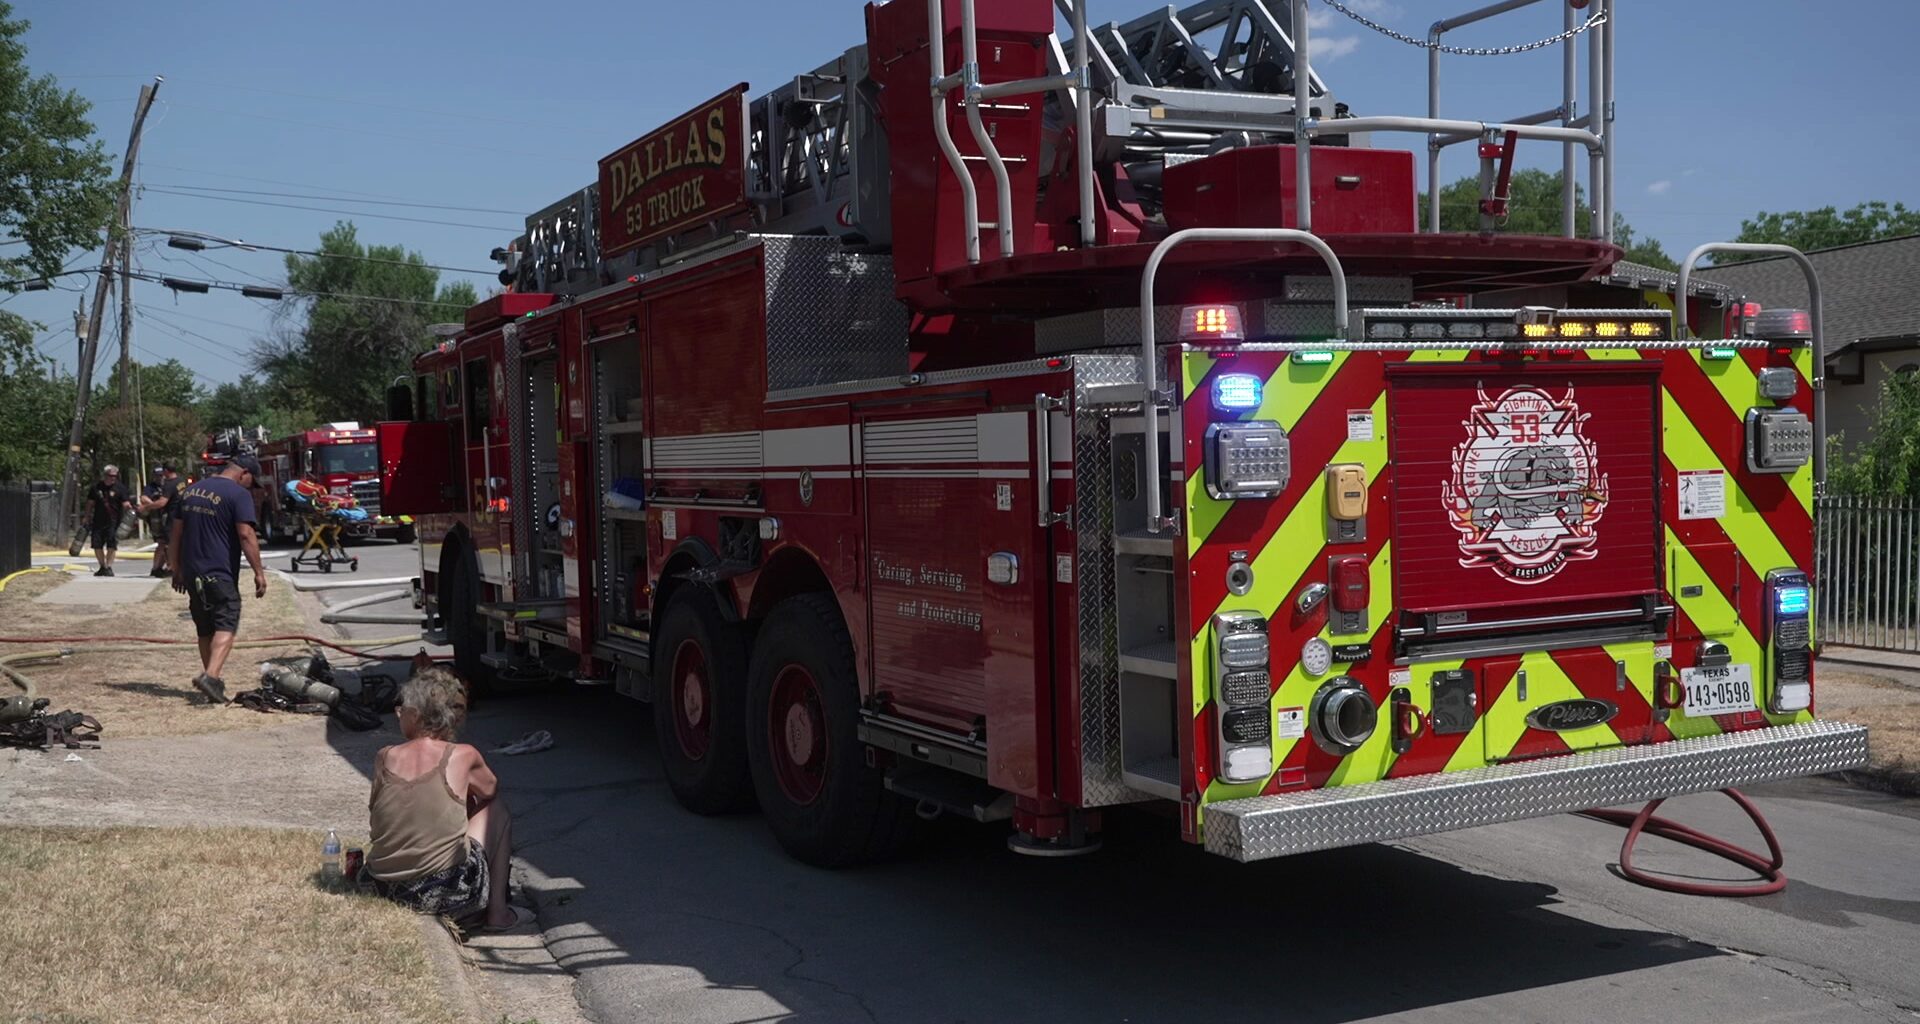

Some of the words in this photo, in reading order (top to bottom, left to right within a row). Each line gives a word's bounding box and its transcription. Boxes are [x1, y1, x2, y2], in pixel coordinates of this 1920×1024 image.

[610, 107, 726, 212] DALLAS
[626, 203, 642, 235] 53
[647, 175, 706, 226] TRUCK
[1503, 395, 1549, 415] FIGHTING
[1511, 414, 1540, 443] 53
[182, 488, 222, 505] DALLAS
[1509, 532, 1550, 551] RESCUE
[1515, 568, 1536, 578] EAST
[1537, 551, 1566, 576] DALLAS
[897, 601, 917, 617] and
[921, 599, 982, 632] Protecting
[1702, 667, 1730, 679] TEXAS
[1547, 704, 1598, 728] Pierce
